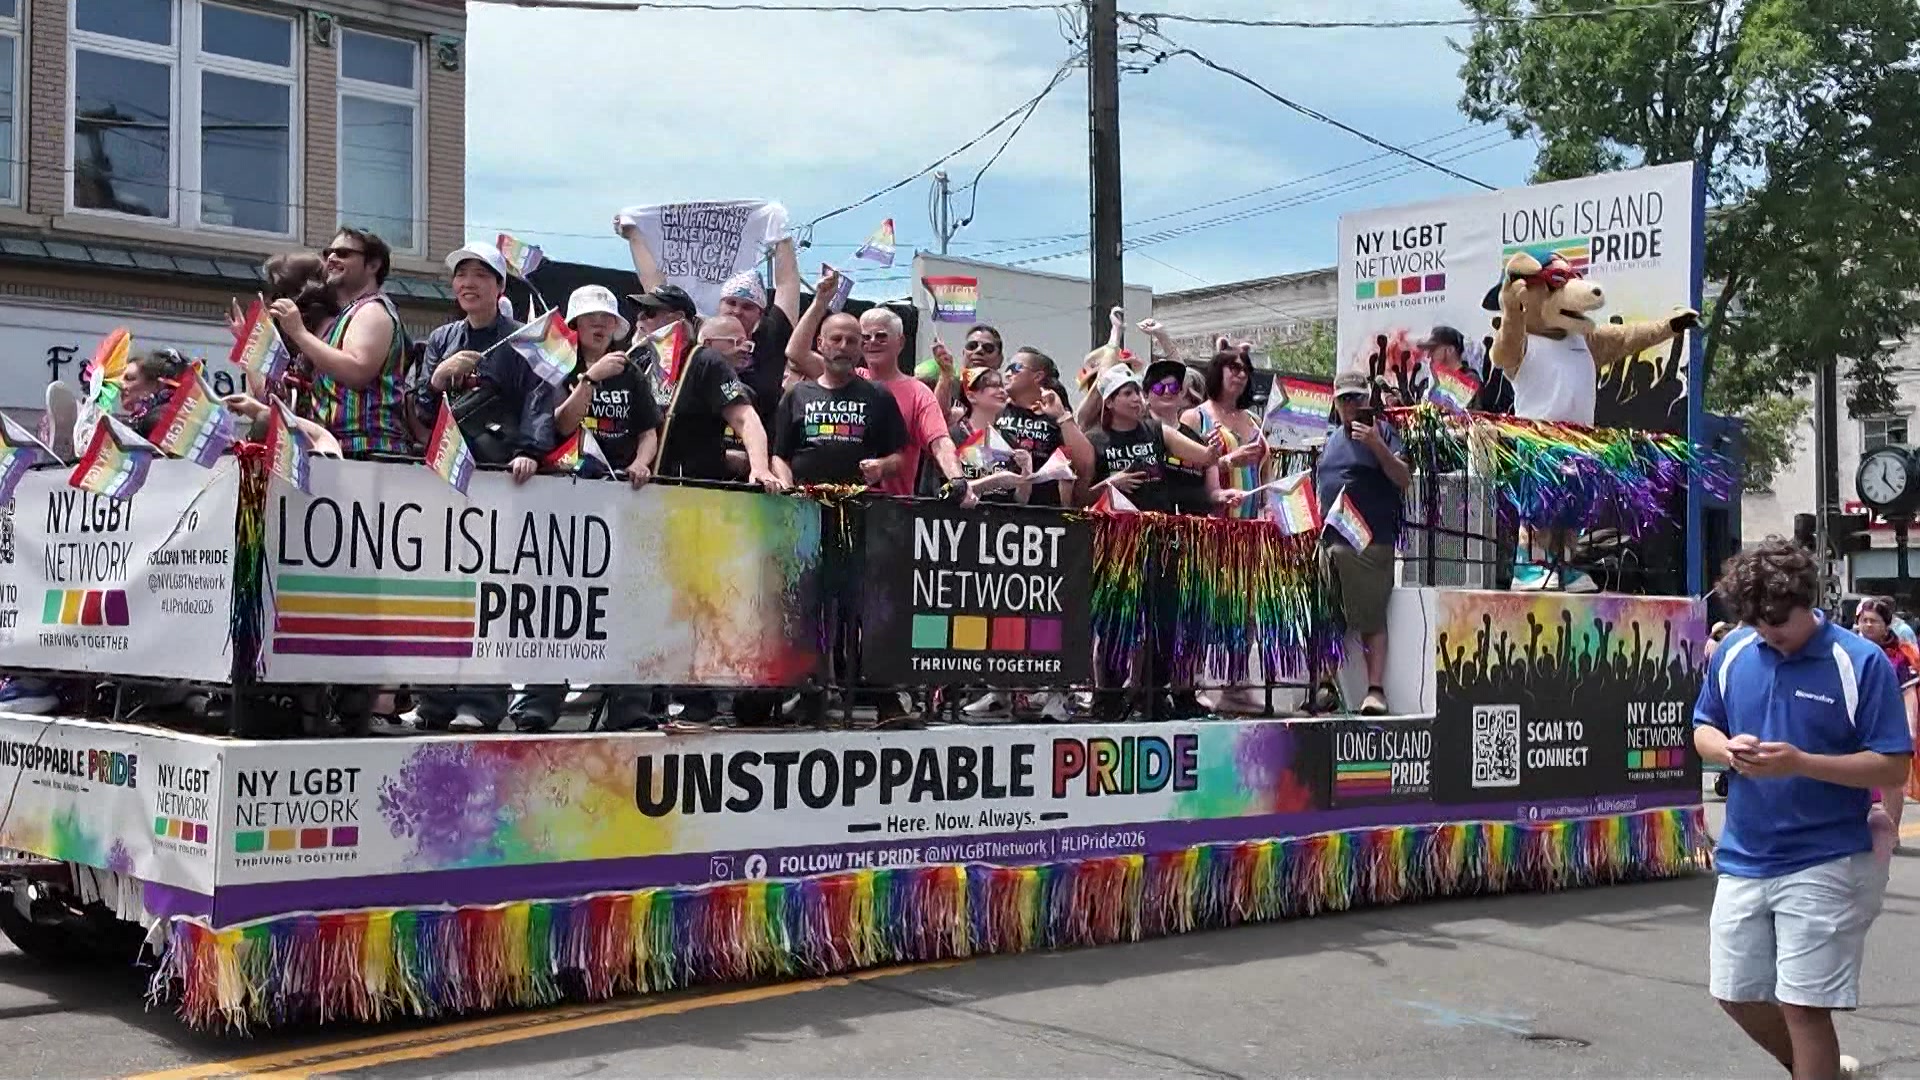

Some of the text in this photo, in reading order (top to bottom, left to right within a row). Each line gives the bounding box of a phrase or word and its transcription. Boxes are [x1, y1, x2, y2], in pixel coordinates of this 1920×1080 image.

[1502, 191, 1663, 244] LONG ISLAND
[662, 226, 740, 250] TAKE YOUR
[1356, 222, 1447, 256] NY LGBT
[1591, 229, 1662, 264] PRIDE
[662, 240, 737, 268] BITCH
[1355, 249, 1446, 279] NETWORK
[661, 261, 689, 276] ASS
[1356, 295, 1446, 311] THRIVING TOGETHER
[593, 388, 630, 404] LGBT
[805, 400, 867, 414] NY LGBT
[804, 412, 867, 426] NETWORK
[46, 489, 133, 534] NY LGBT
[277, 495, 612, 578] LONG ISLAND
[914, 517, 1067, 568] NY LGBT
[44, 541, 134, 583] NETWORK
[181, 549, 197, 566] THE
[199, 549, 228, 565] PRIDE
[6, 585, 17, 603] TO
[913, 568, 1064, 612] NETWORK
[478, 581, 610, 640] PRIDE
[38, 633, 130, 651] THRIVING TOGETHER
[477, 641, 607, 661] BY NY LGBT NETWORK
[911, 657, 1062, 673] THRIVING TOGETHER
[1627, 701, 1685, 724] NY LGBT
[1527, 720, 1584, 742] SCAN TO
[1627, 726, 1685, 748] NETWORK
[1336, 730, 1432, 761] LONG ISLAND
[1527, 746, 1589, 769] CONNECT
[0, 740, 138, 789] NSTOPPABLE PRIDE
[635, 733, 1199, 818] UNSTOPPABLE PRIDE
[1391, 760, 1430, 786] PRIDE
[158, 764, 211, 795] NY LGBT
[237, 767, 361, 798] NY LGBT
[156, 790, 209, 821] NETWORK
[236, 798, 359, 827] NETWORK
[887, 808, 1036, 833] Here. Now. Always.
[235, 851, 358, 868] THRIVING TOGETHER
[779, 852, 843, 873] FOLLOW
[846, 851, 874, 868] THE
[878, 847, 921, 867] PRIDE
[924, 839, 1049, 863] @NYLGBTNetwork
[1061, 830, 1147, 853] #LIPride2026
